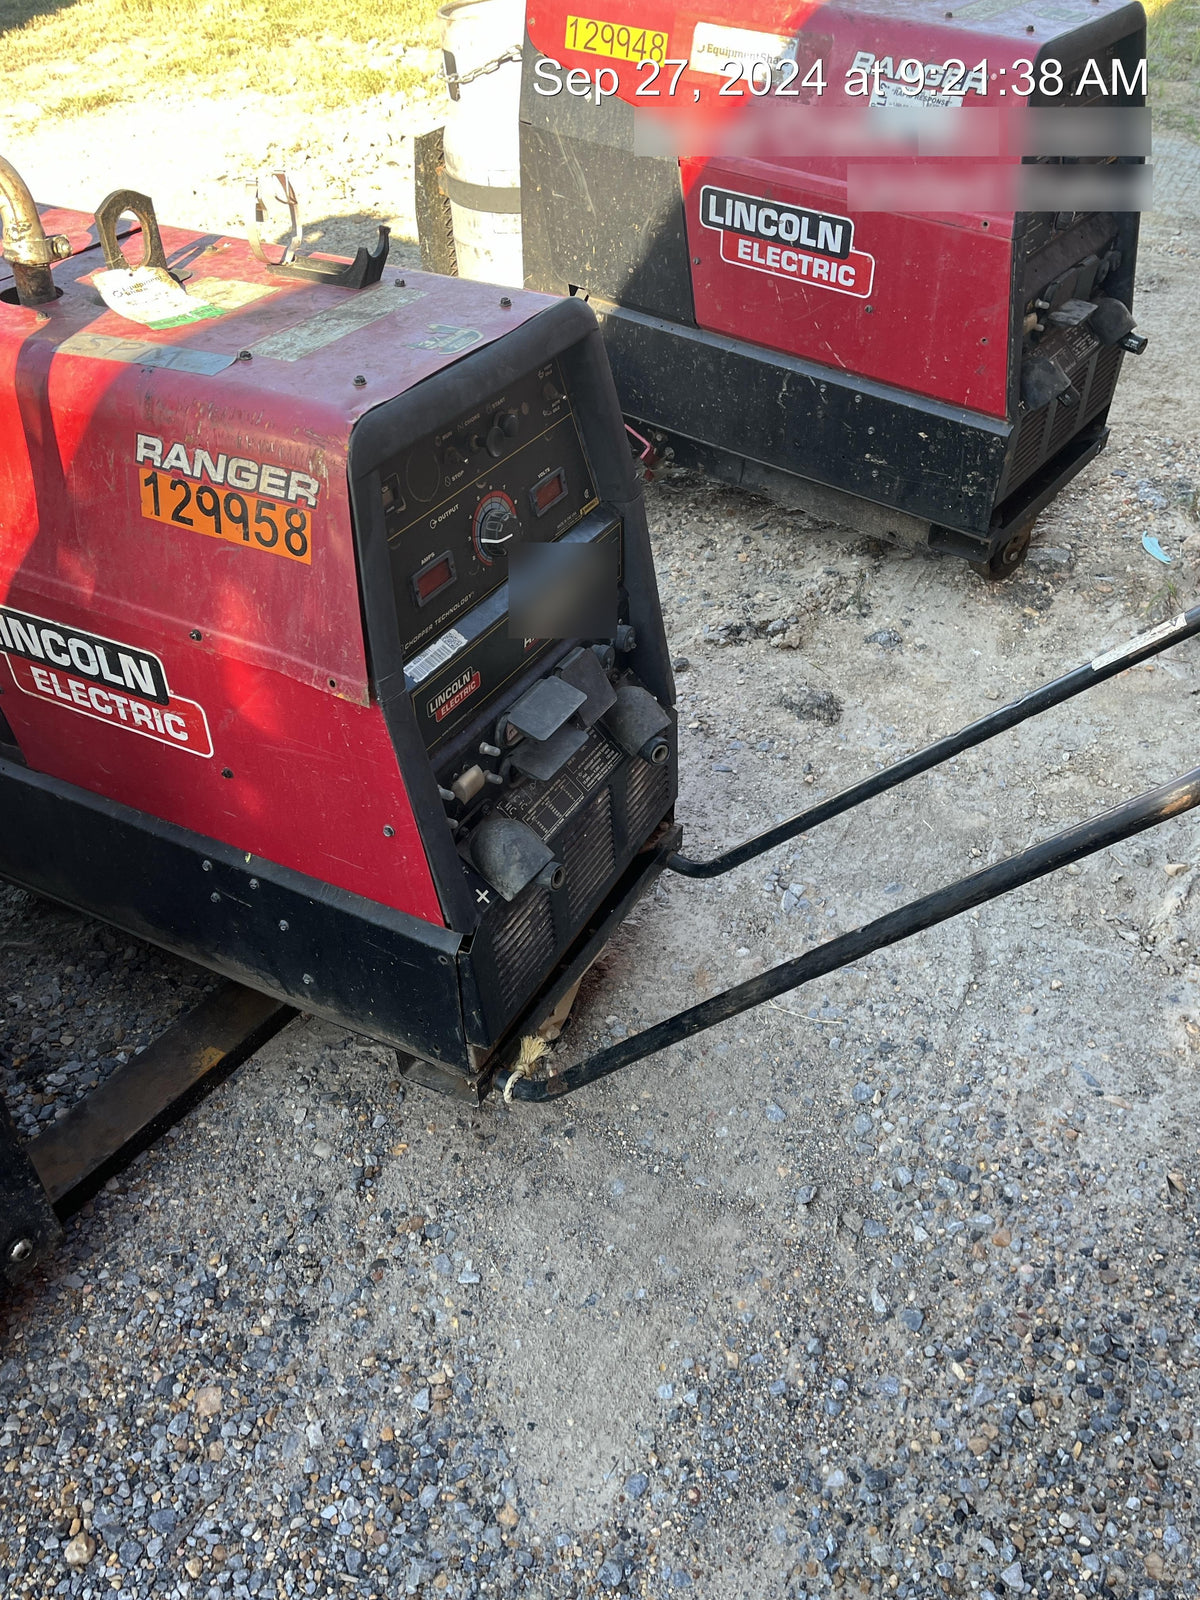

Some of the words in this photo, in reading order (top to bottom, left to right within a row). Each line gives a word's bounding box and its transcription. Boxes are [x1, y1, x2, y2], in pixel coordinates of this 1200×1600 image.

[567, 16, 666, 63] 129948
[710, 195, 843, 253] LINCOLN
[738, 240, 856, 289] ELECTRIC
[136, 434, 320, 508] RANGER
[451, 469, 465, 482] STOP
[143, 471, 309, 558] 129958
[437, 503, 460, 522] OUTPUT
[420, 552, 436, 566] AMPS
[404, 625, 433, 650] CHOPPER
[434, 594, 473, 626] TECHNOLOGY
[0, 615, 158, 697] INCOLN
[29, 665, 190, 742] ELECTRIC
[429, 671, 471, 713] LINCOLN
[441, 680, 477, 716] ELECTRIC
